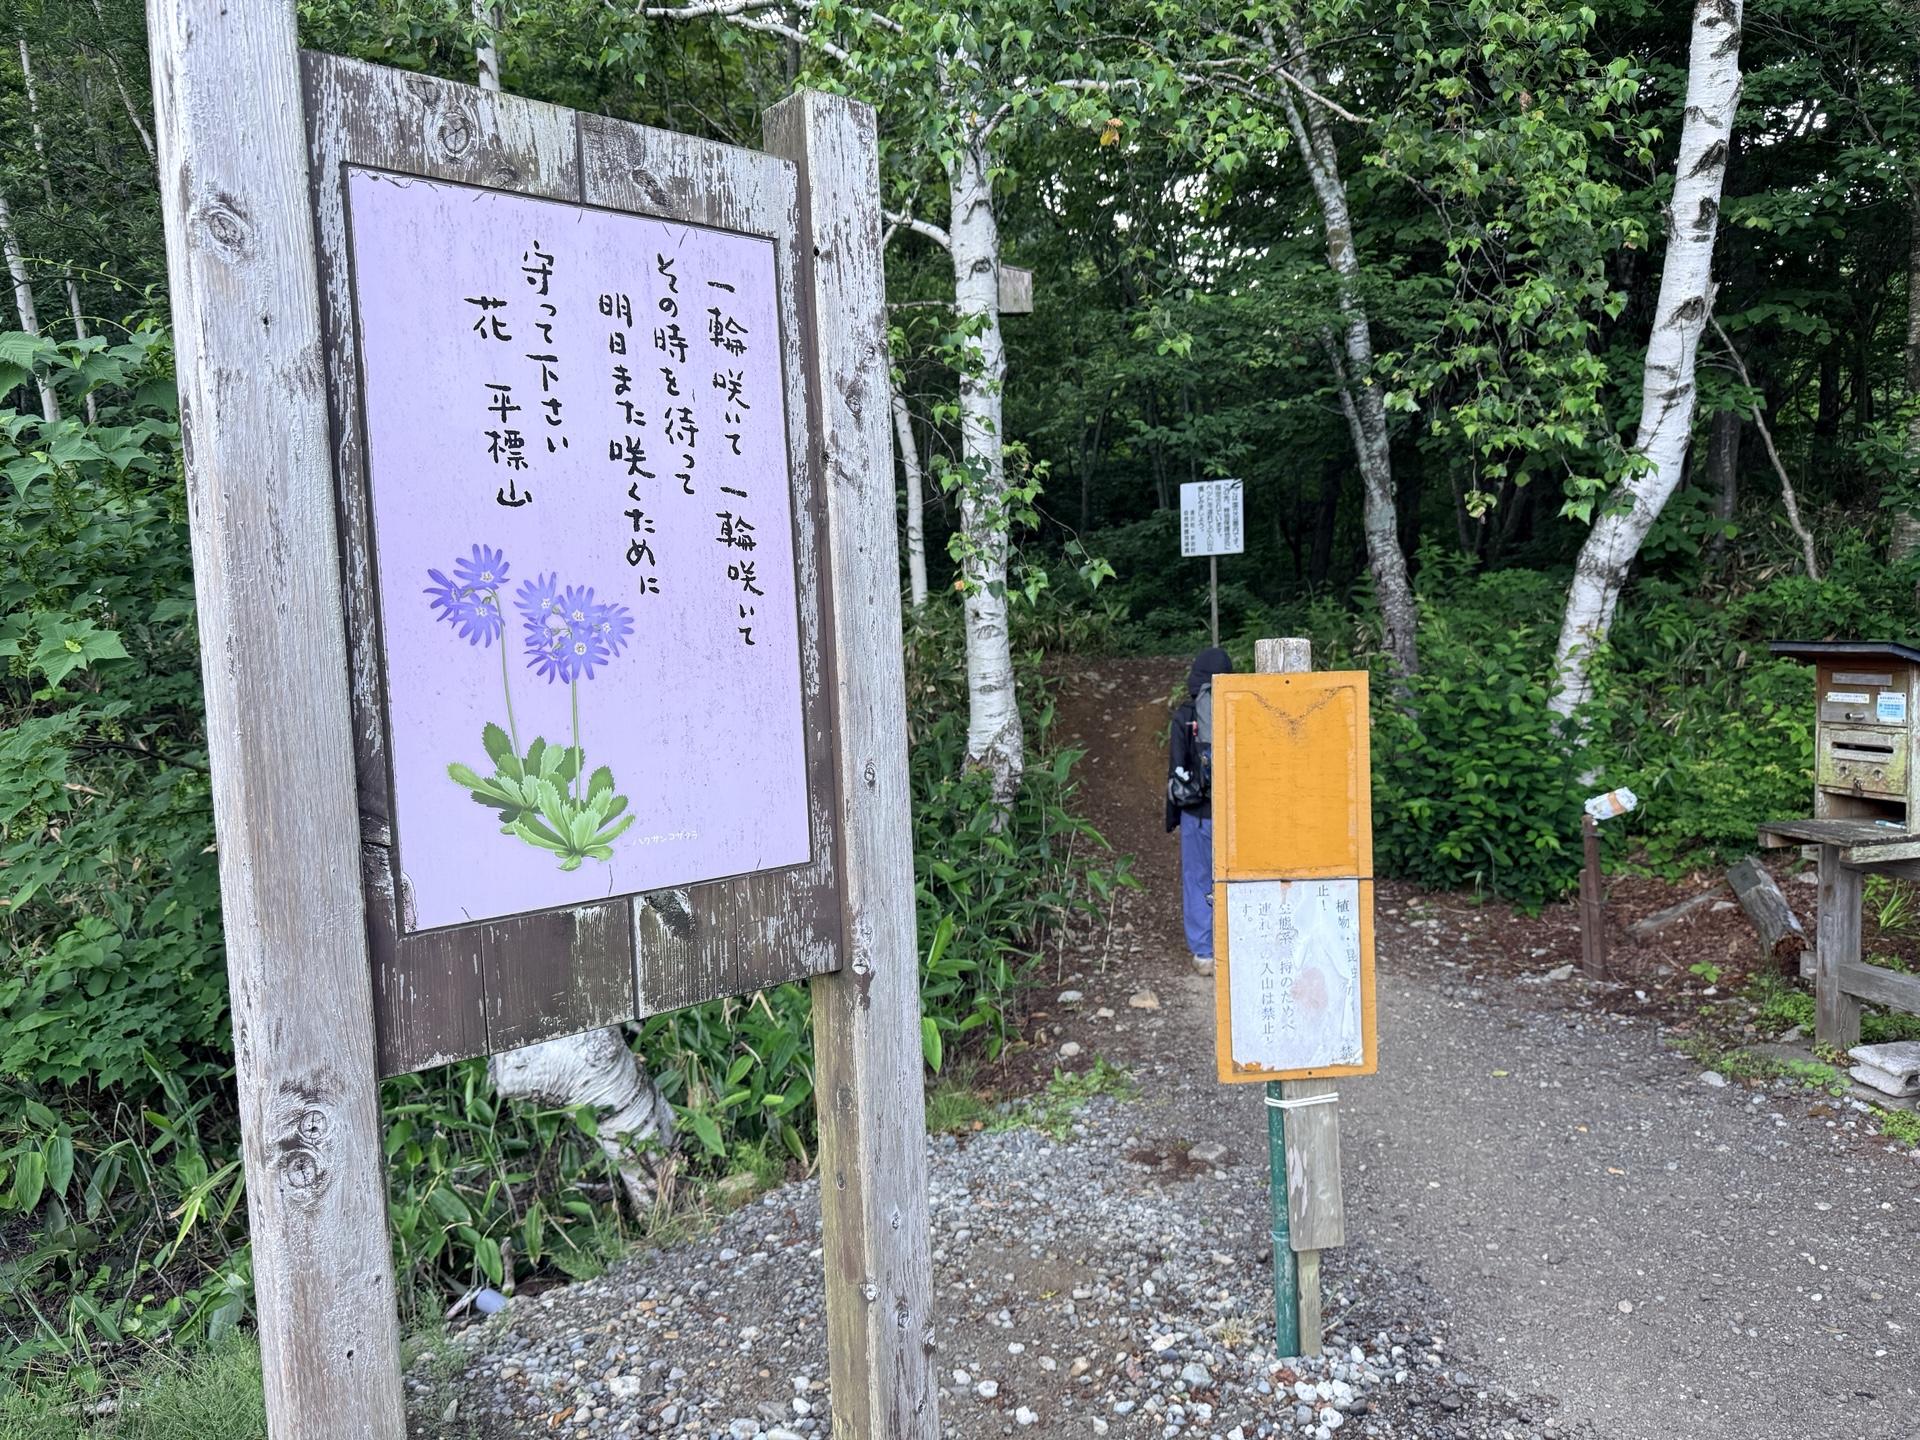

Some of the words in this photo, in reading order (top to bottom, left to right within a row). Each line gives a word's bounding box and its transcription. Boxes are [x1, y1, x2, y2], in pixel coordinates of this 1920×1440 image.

[463, 296, 513, 343] 花
[521, 240, 570, 455] 守って下さい
[653, 253, 700, 497] その時を待って
[707, 282, 750, 457] 一輪咲いて
[484, 383, 534, 509] 平標山
[598, 292, 660, 597] 明日また咲くために
[716, 486, 766, 647] 一輪咲いて
